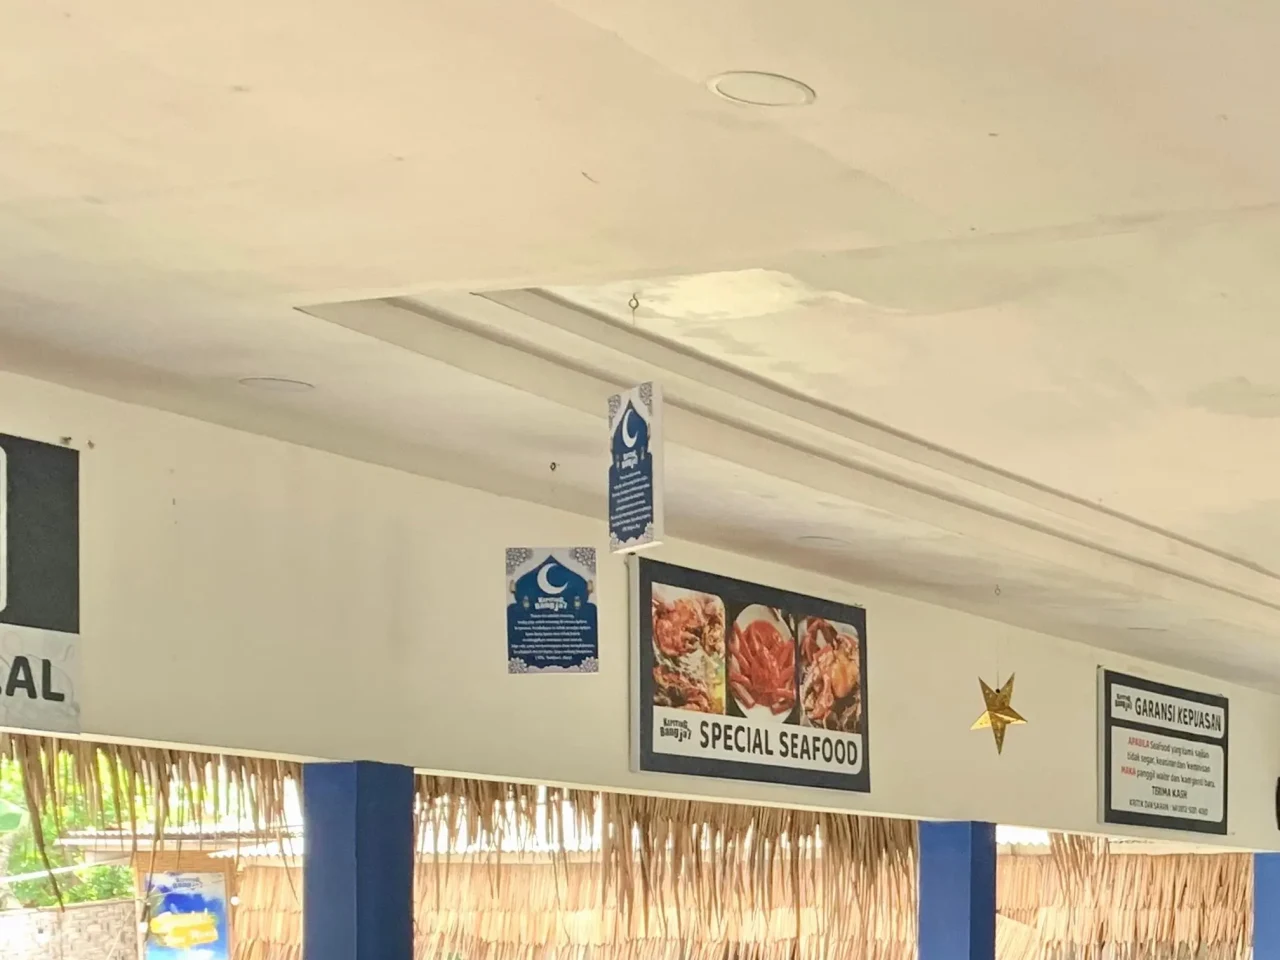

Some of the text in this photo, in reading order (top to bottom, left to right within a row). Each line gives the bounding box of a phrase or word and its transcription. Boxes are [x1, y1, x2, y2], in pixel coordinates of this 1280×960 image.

[0, 655, 65, 702] AL
[1134, 697, 1176, 723] GARANSI
[1177, 706, 1222, 732] KEPUASAN
[699, 719, 859, 766] SPECIAL SEAFOOD
